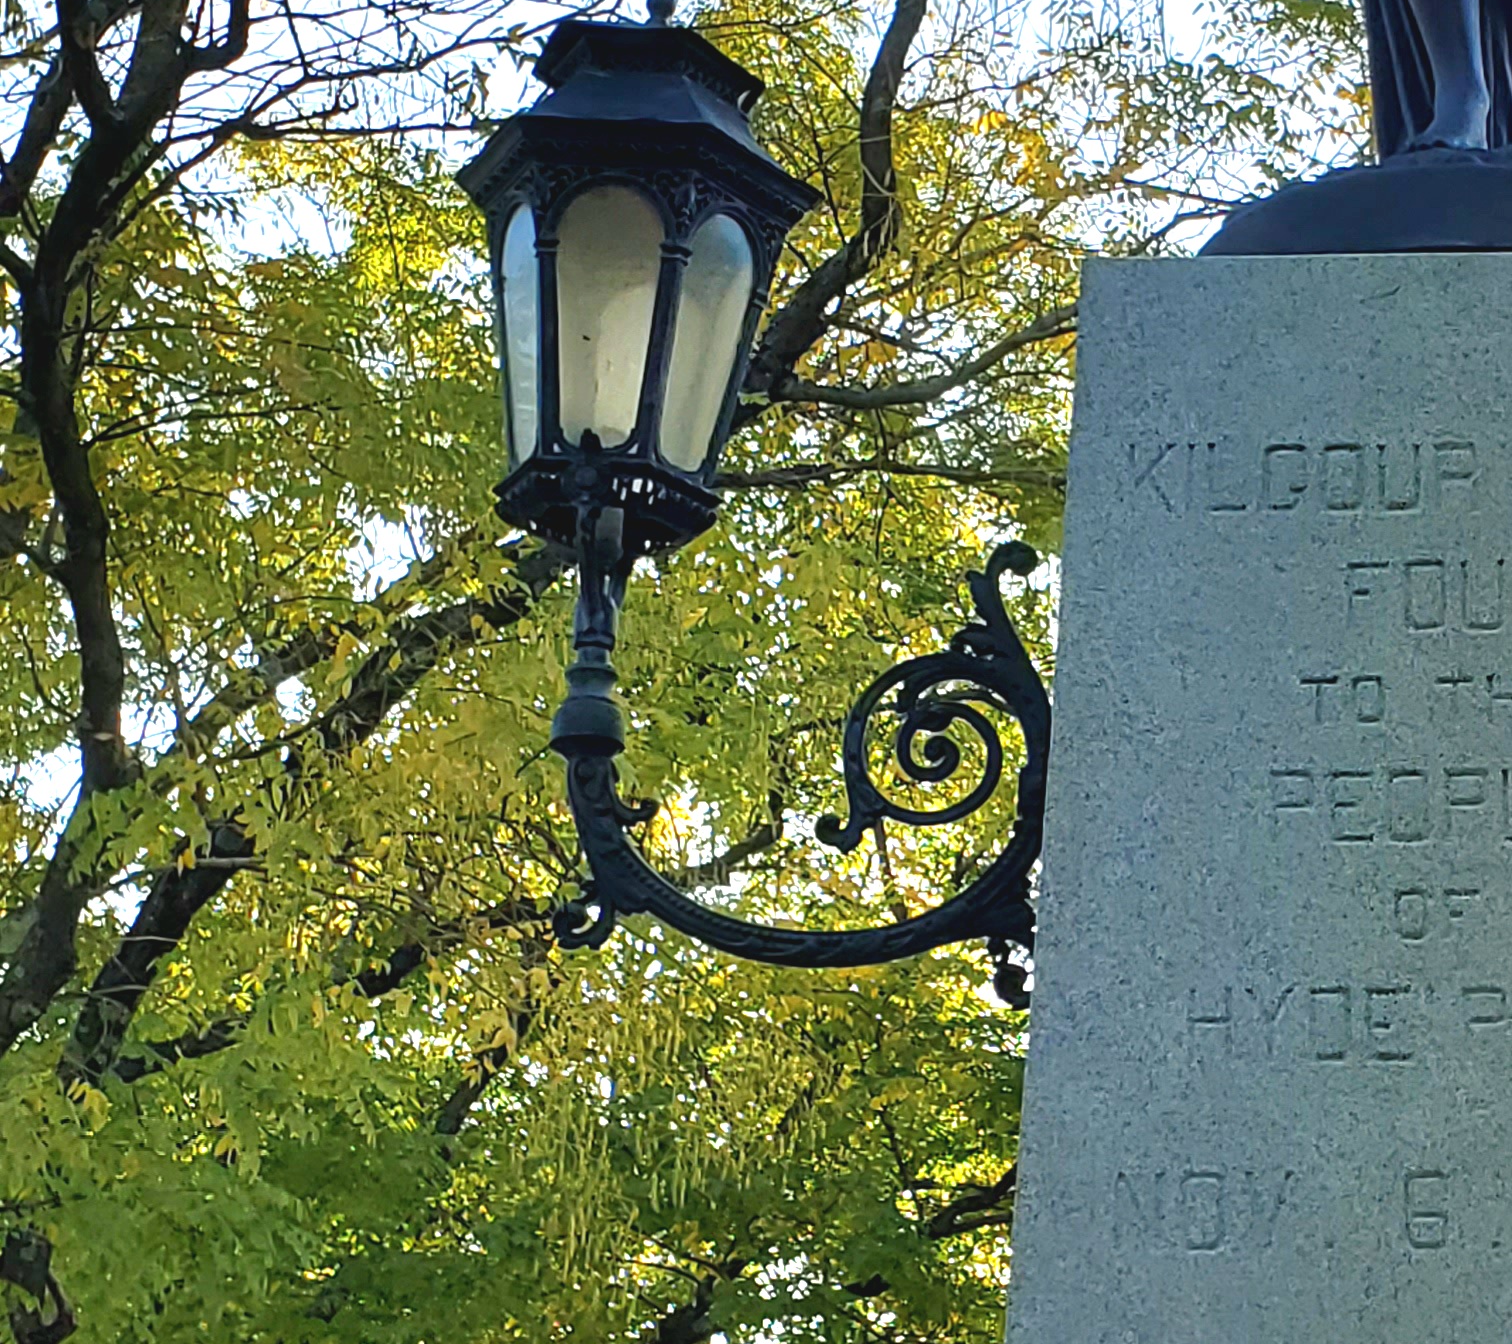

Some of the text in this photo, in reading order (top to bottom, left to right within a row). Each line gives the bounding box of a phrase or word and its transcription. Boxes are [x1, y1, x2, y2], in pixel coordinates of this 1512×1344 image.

[1298, 673, 1386, 726] TO
[1393, 886, 1483, 941] OF
[1184, 980, 1413, 1063] HYDE
